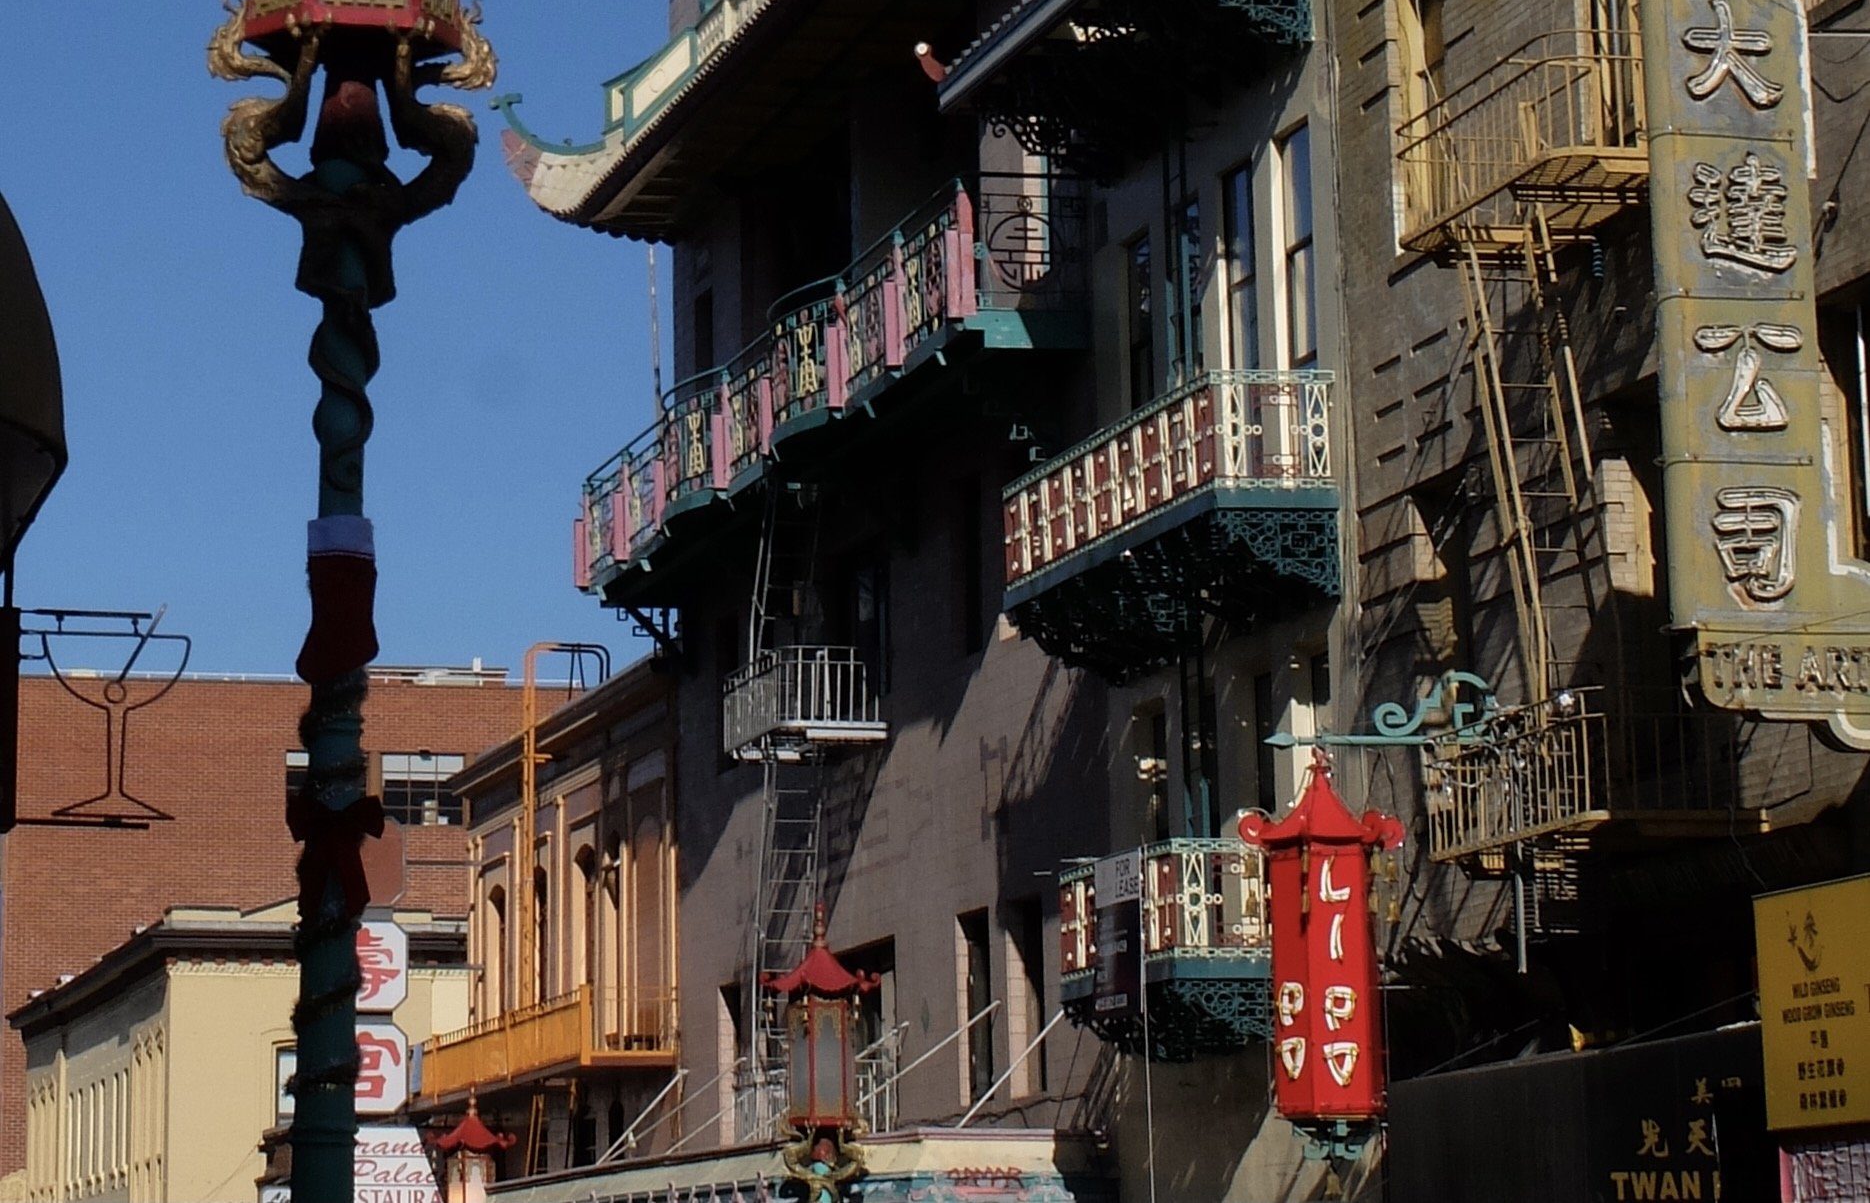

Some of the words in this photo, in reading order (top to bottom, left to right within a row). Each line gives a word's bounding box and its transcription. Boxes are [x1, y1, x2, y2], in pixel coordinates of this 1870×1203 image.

[1703, 643, 1783, 690] THE
[1115, 858, 1131, 877] FOR
[1115, 876, 1139, 897] LEASE
[354, 1158, 436, 1184] Palac
[1610, 1171, 1702, 1200] TWAN
